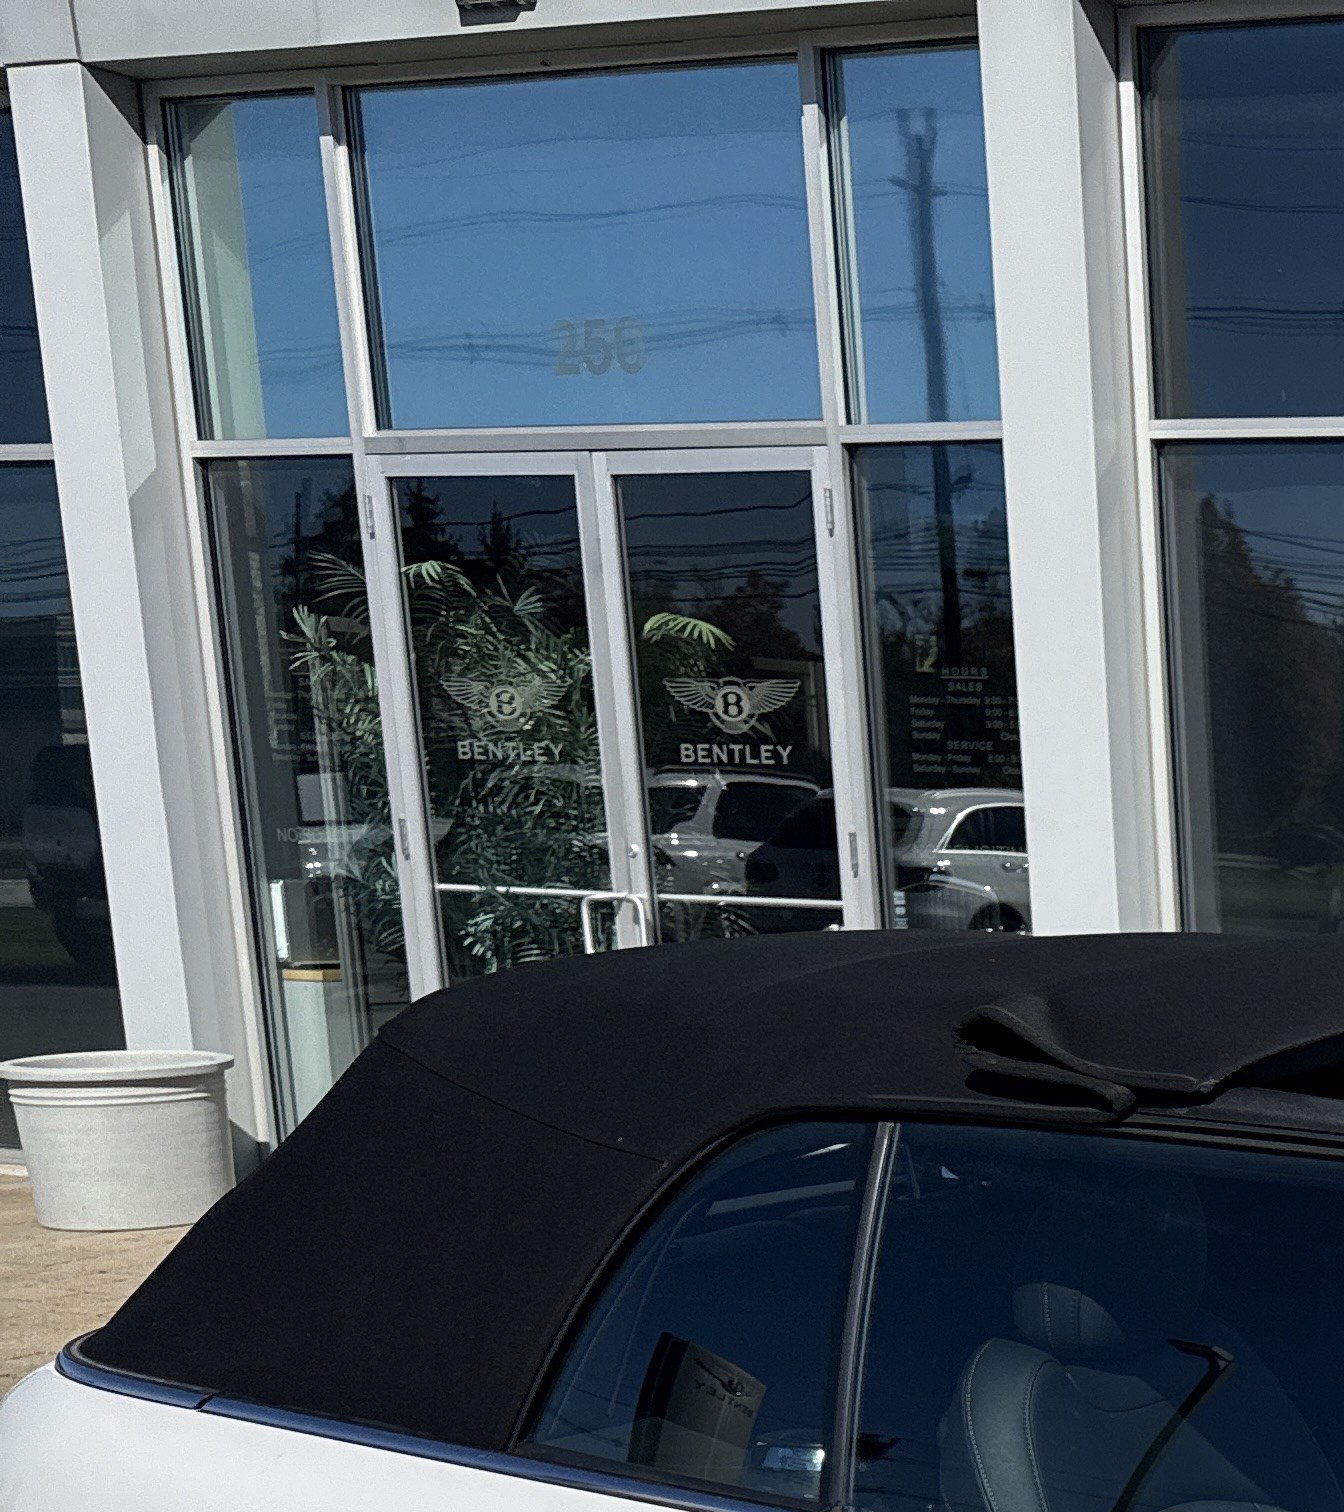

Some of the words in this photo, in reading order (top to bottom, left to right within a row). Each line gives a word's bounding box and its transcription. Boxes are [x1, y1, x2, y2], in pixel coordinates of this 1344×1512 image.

[941, 667, 988, 677] HOURS
[947, 682, 983, 692] SALES
[947, 741, 994, 751] SERVICE
[456, 741, 563, 762] BENTLEY
[680, 743, 793, 765] BENTLEY
